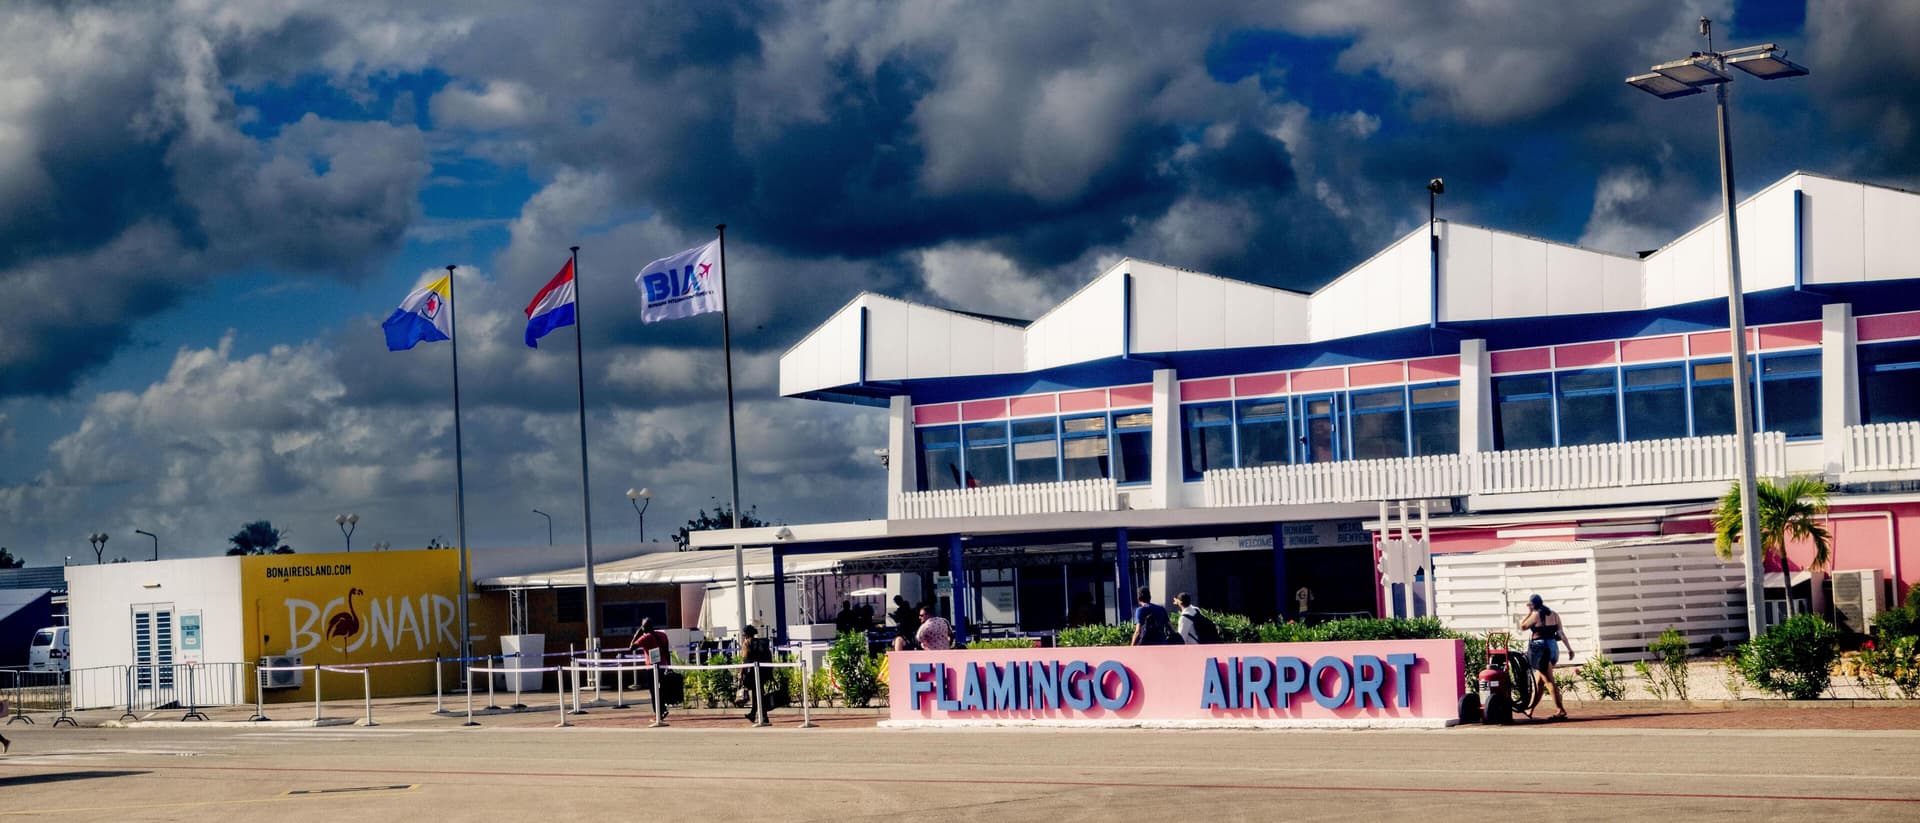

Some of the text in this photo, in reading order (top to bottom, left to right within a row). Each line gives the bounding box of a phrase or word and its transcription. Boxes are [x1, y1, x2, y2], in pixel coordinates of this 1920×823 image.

[643, 264, 700, 302] BIA
[266, 565, 352, 578] BONAIREISLAND.COM
[284, 596, 487, 656] BONAIRE
[909, 652, 1418, 712] FLAMINGO AIRPORT
